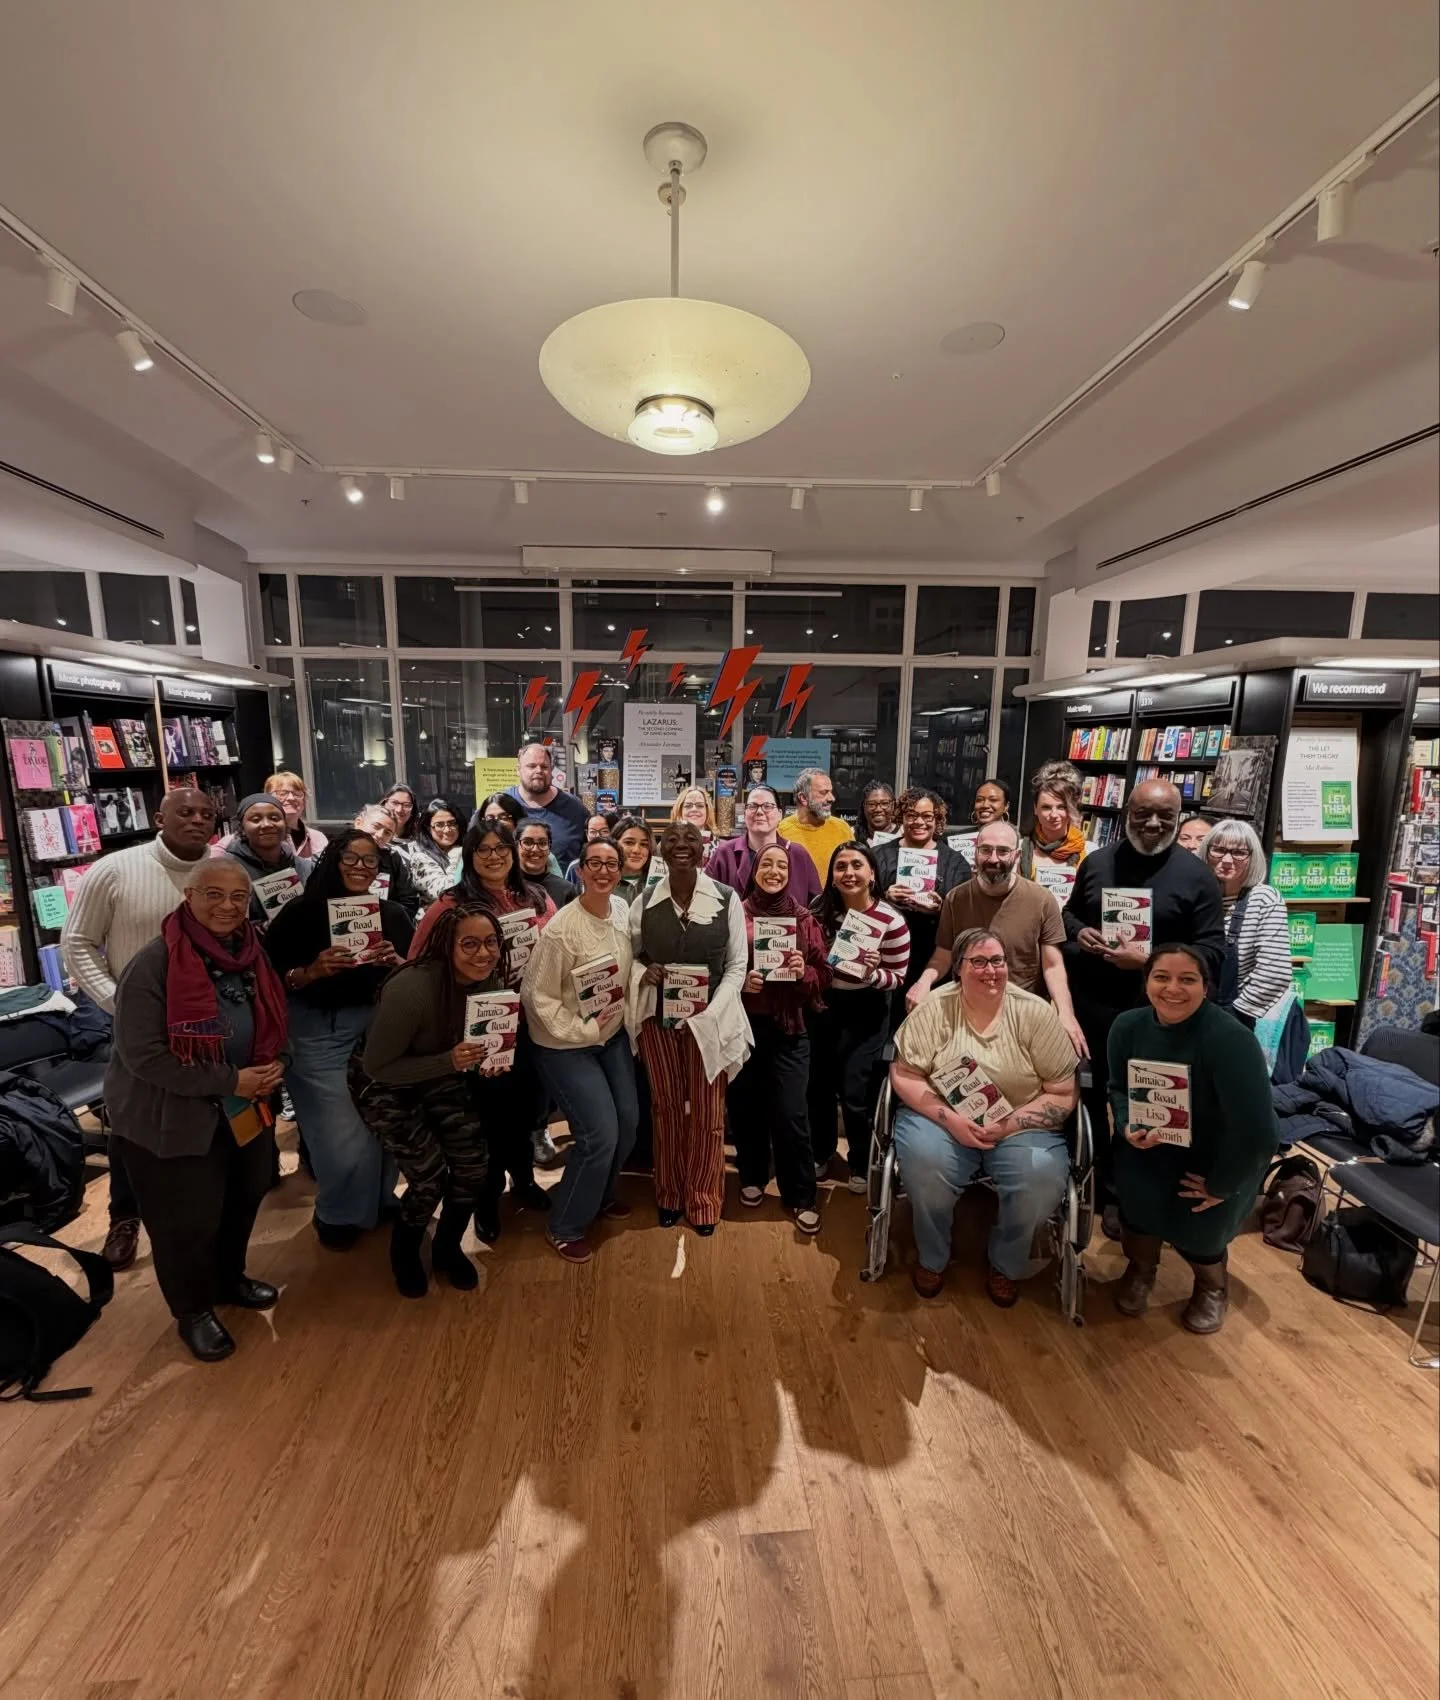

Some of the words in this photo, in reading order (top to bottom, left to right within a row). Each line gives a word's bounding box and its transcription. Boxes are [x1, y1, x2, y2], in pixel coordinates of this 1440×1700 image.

[1312, 683, 1328, 694] We
[1329, 683, 1387, 694] recommend
[1328, 795, 1346, 804] LET
[1323, 804, 1351, 815] THEM
[1279, 867, 1296, 876] LET
[1307, 867, 1324, 876] LET
[1334, 867, 1352, 876] LET
[1272, 876, 1300, 885] THEM
[1301, 876, 1327, 885] THEM
[1329, 876, 1356, 885] THEM
[262, 882, 287, 896] Jamaica
[281, 890, 298, 902] Road
[1107, 898, 1133, 908] Jamaica
[336, 907, 364, 920] Jamaica
[1122, 912, 1141, 921] Road
[353, 919, 373, 931] Road
[1291, 925, 1309, 934] LET
[758, 927, 782, 936] Jamaica
[349, 936, 365, 947] Lisa
[516, 933, 533, 945] Road
[772, 939, 789, 949] Road
[513, 950, 528, 962] Lisa
[766, 953, 782, 963] Lisa
[580, 973, 605, 988] Jamaica
[597, 979, 614, 992] Road
[668, 975, 693, 986] Jamaica
[682, 989, 700, 999] Road
[476, 1007, 504, 1018] Jamaica
[676, 1003, 691, 1013] Lisa
[491, 1020, 510, 1031] Road
[483, 1039, 499, 1050] Lisa
[489, 1053, 511, 1066] Smith
[941, 1071, 966, 1090] Jamaica
[1134, 1072, 1167, 1088] Jamaica
[963, 1078, 982, 1094] Road
[1153, 1091, 1177, 1105] Road
[968, 1098, 985, 1112] Lisa
[986, 1105, 1008, 1121] Smith
[1145, 1109, 1166, 1122] Lisa
